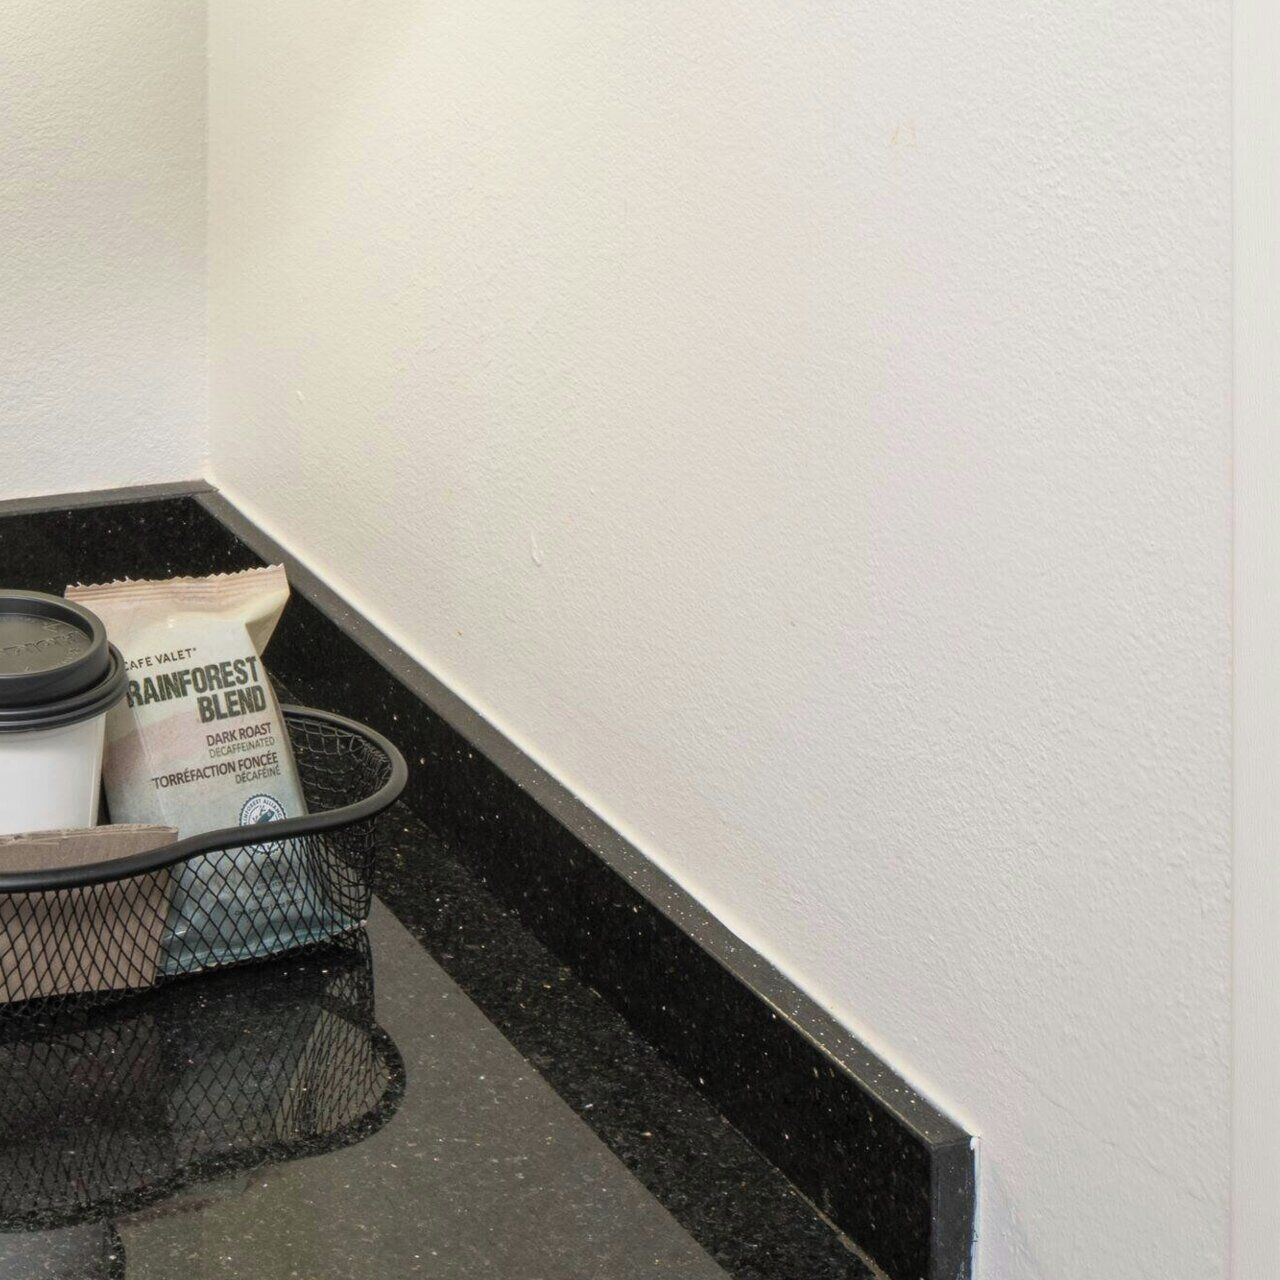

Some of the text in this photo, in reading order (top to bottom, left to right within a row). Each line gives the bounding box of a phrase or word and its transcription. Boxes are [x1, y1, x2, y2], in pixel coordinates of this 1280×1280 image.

[126, 655, 258, 708] RAINFOREST
[197, 685, 267, 724] BLEND
[206, 722, 271, 747] DARK ROAST
[208, 736, 275, 759] DECAFFEINATED
[152, 750, 279, 790] TORRÉFACTION FONCÉE
